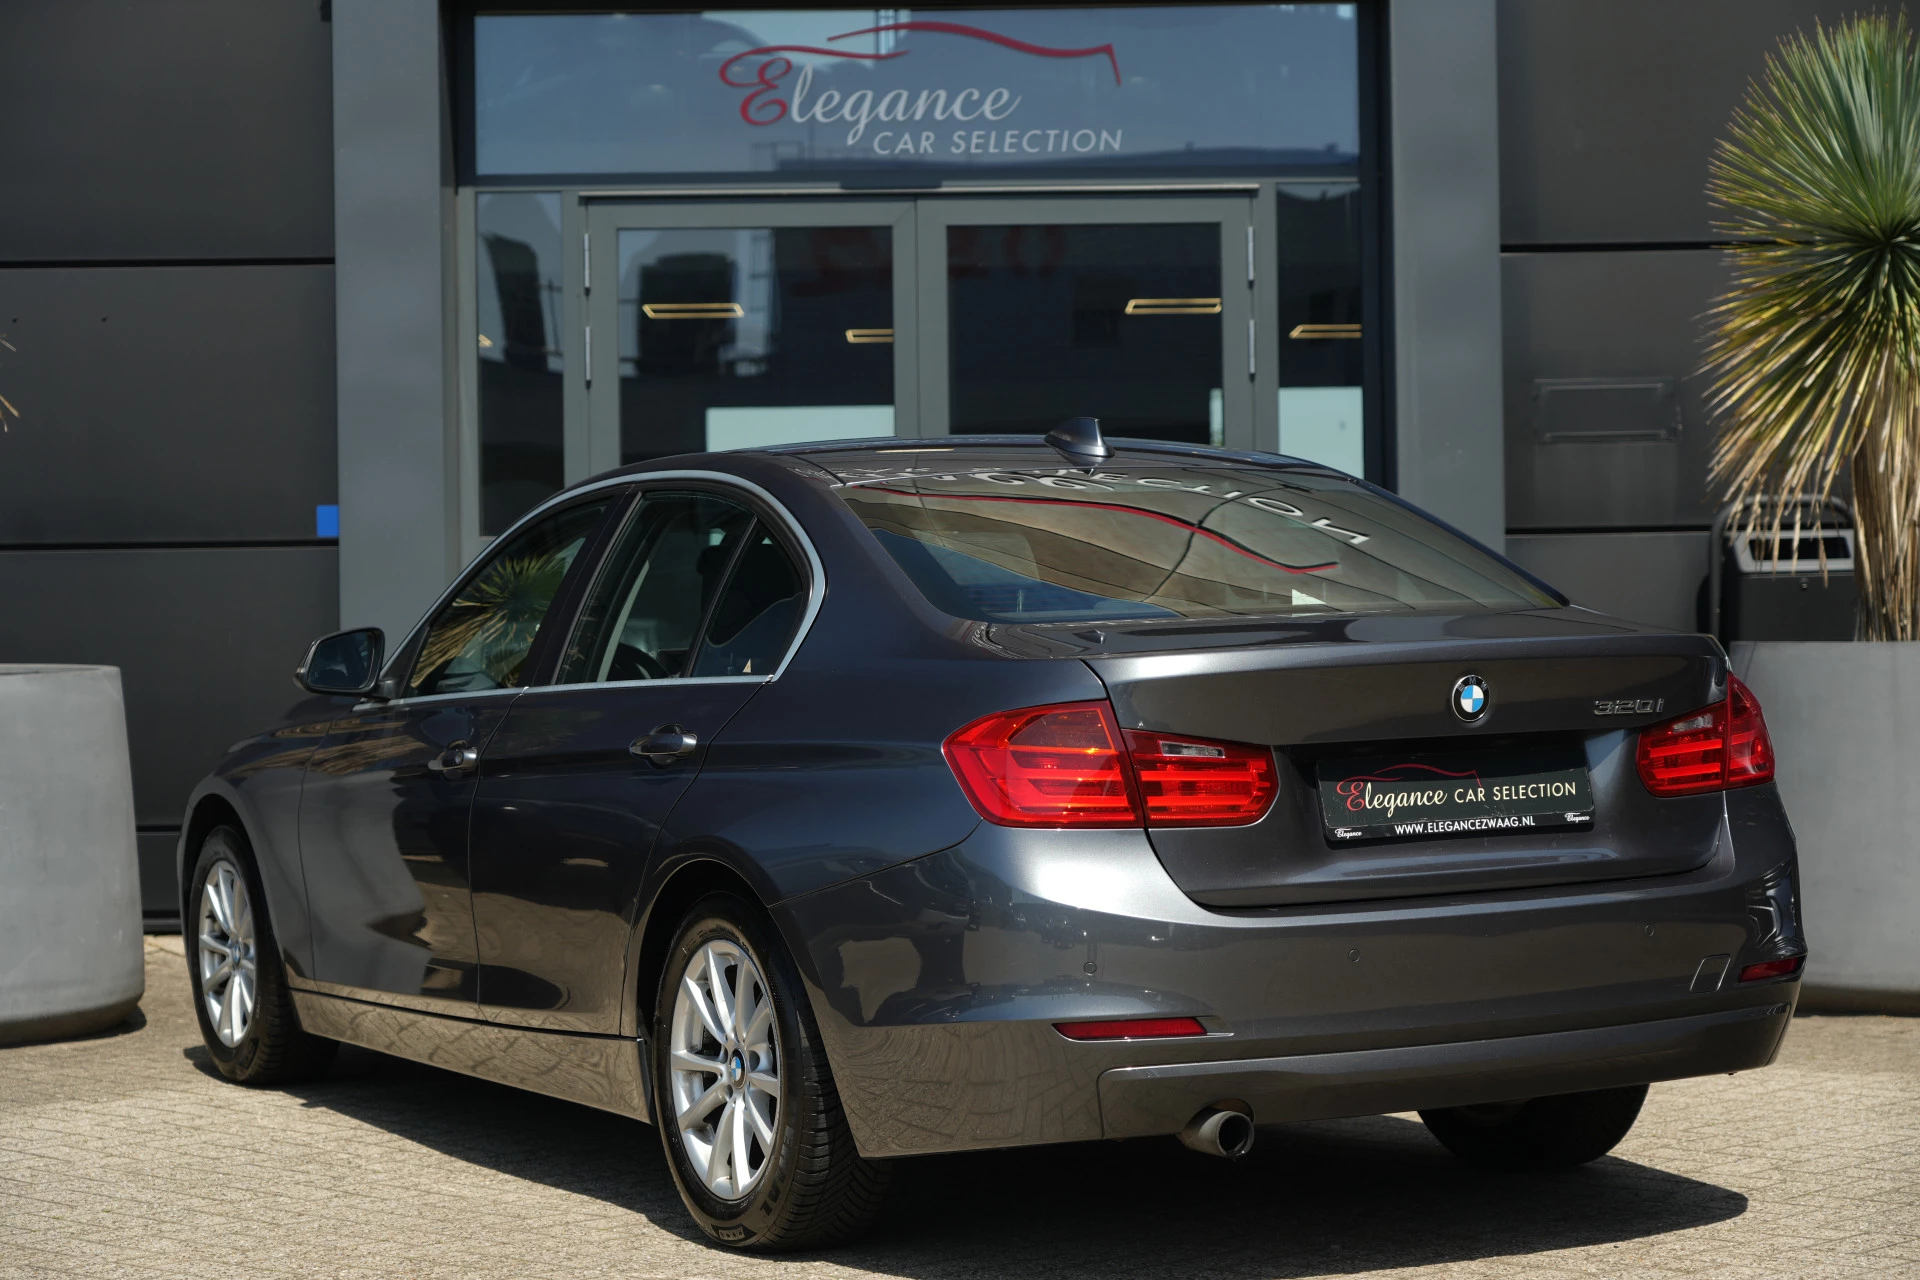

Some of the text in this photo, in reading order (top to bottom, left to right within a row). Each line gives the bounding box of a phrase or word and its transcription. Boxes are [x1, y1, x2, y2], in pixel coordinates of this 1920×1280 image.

[719, 45, 1021, 146] Elegance
[873, 129, 1122, 155] CAR SELECTION
[1593, 698, 1665, 716] 320i
[1336, 775, 1577, 817] Elegance CAR SELECTION
[1394, 815, 1536, 835] WWW.ELEGANCEZWAAG.NL
